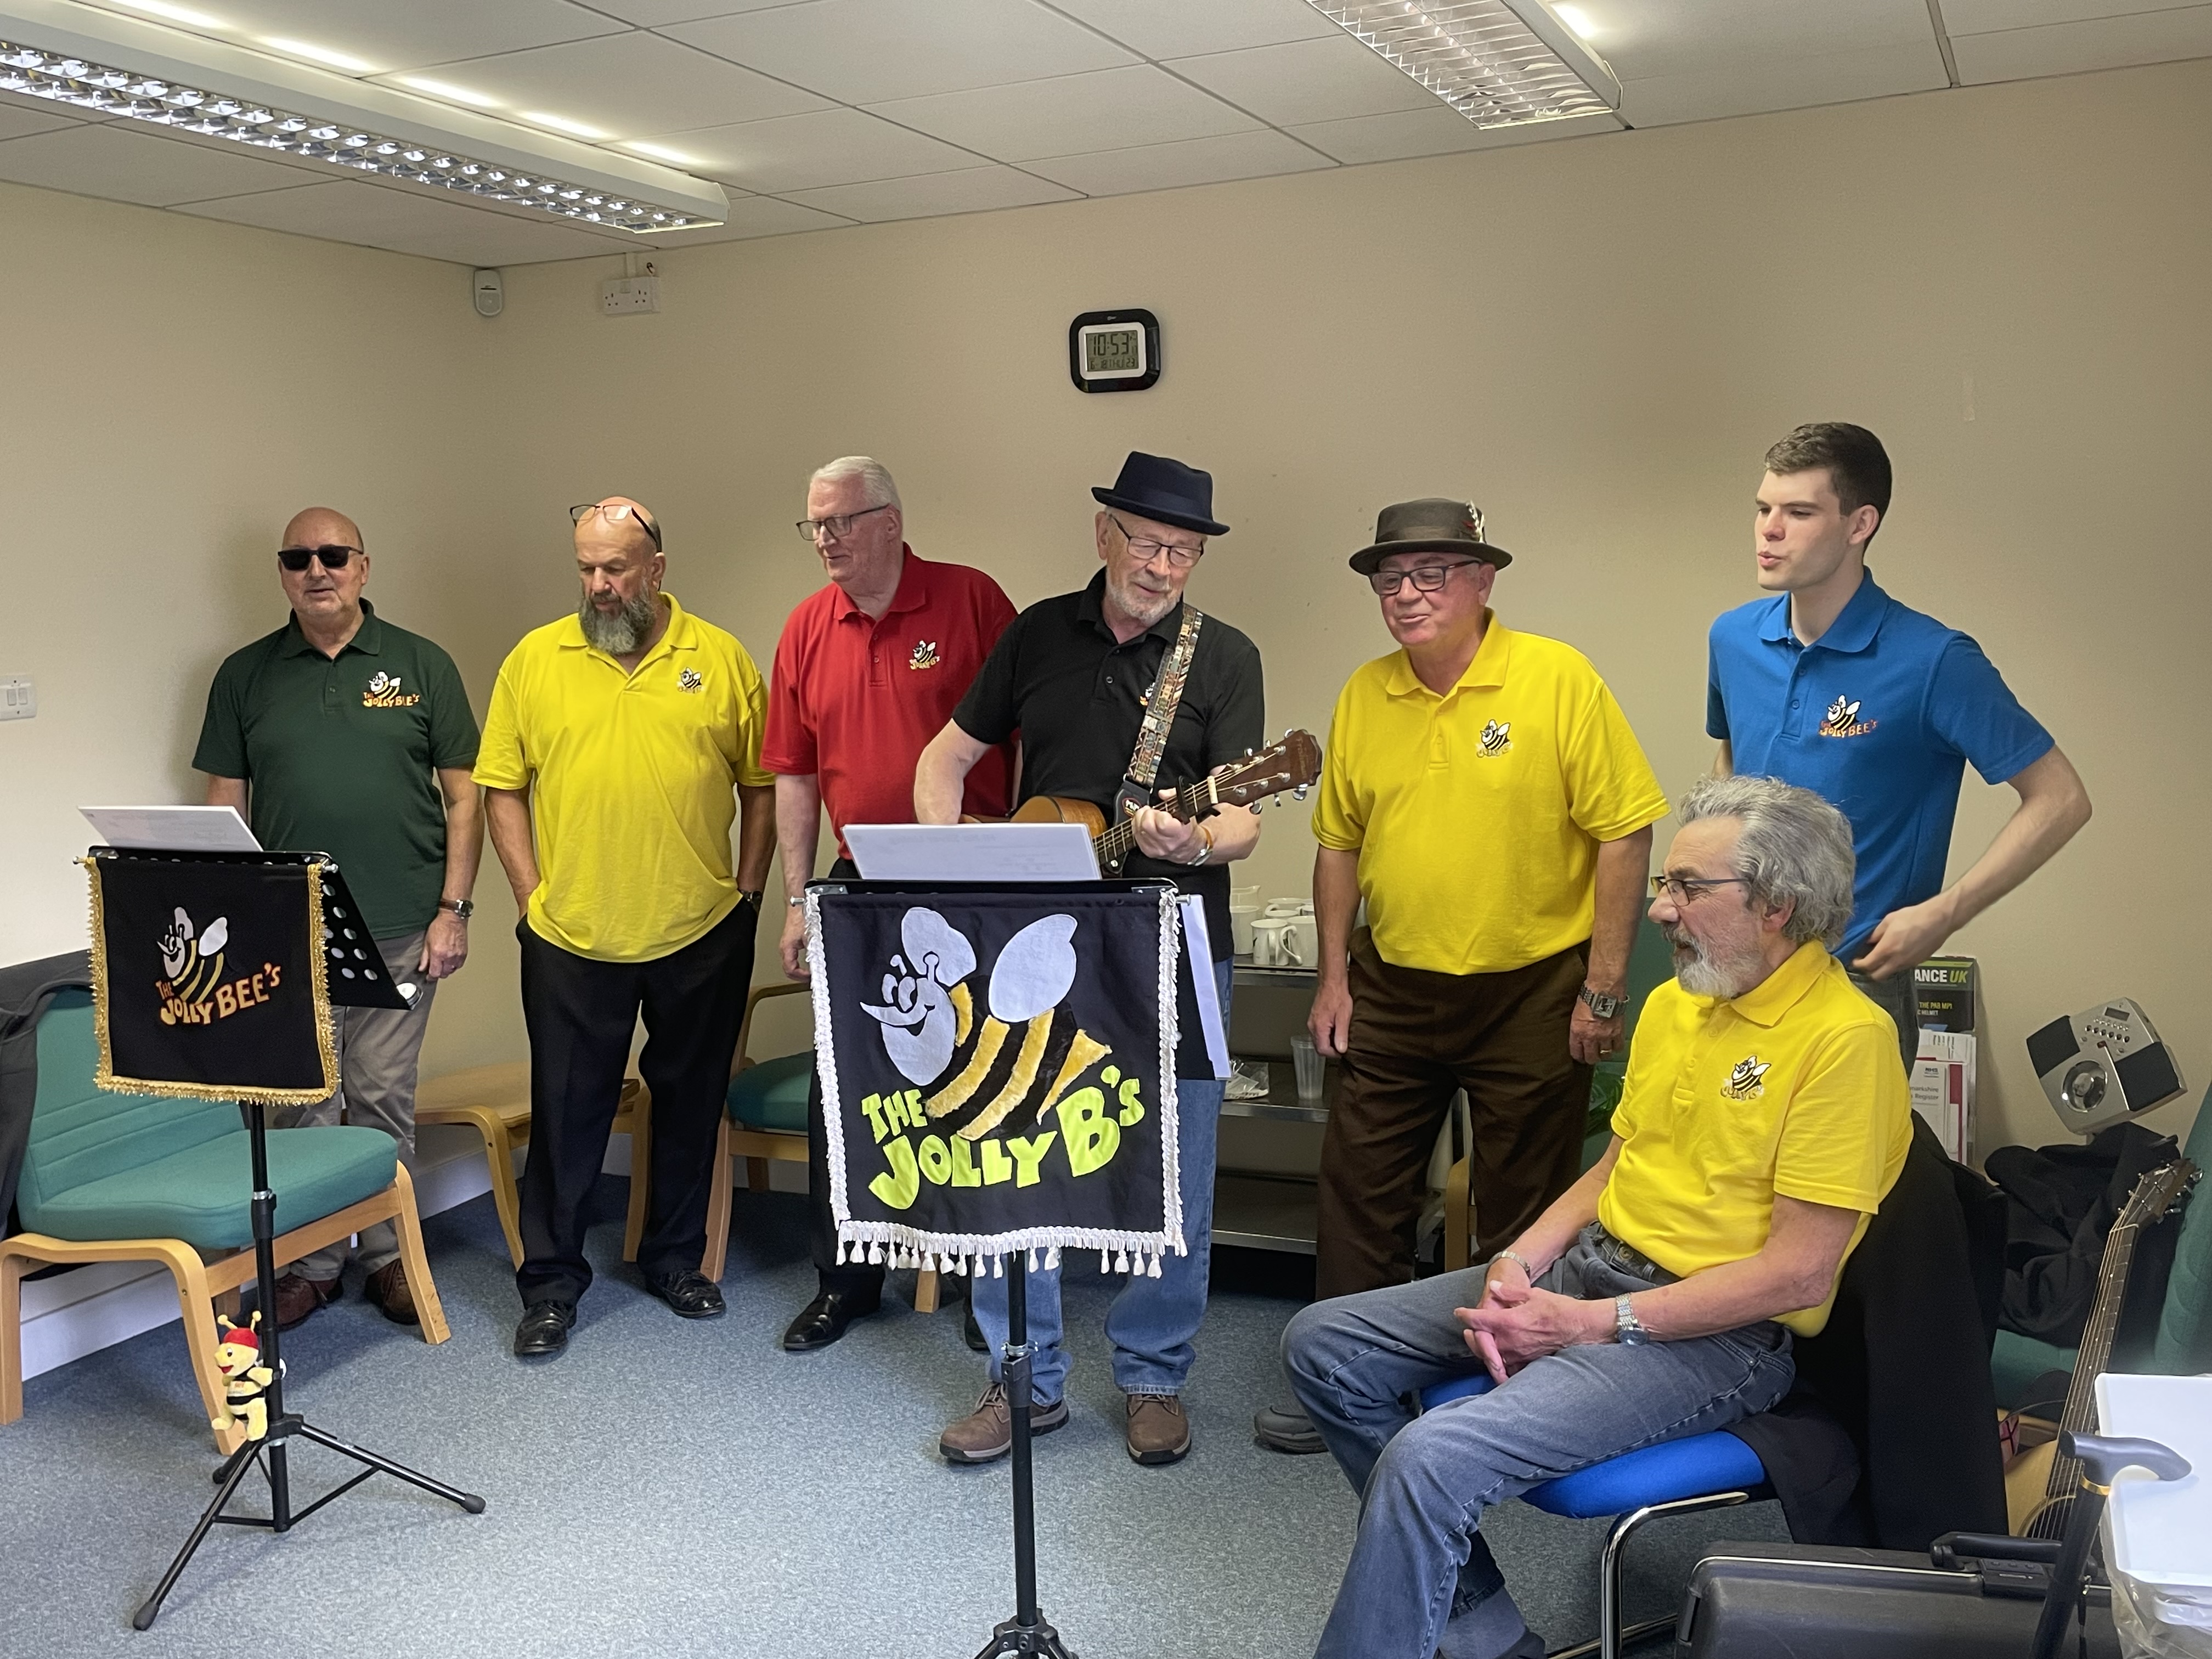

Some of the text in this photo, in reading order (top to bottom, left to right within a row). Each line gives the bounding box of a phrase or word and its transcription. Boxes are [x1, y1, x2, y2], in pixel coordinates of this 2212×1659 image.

[1093, 333, 1129, 356] 10:53
[363, 698, 394, 707] JOLLY
[1819, 727, 1847, 738] JOLLY
[1914, 969, 1968, 983] ANCE UK
[155, 980, 174, 1000] THE
[160, 997, 214, 1025] JOLLY
[861, 1089, 928, 1144] THE
[868, 1131, 1058, 1210] JOLLY
